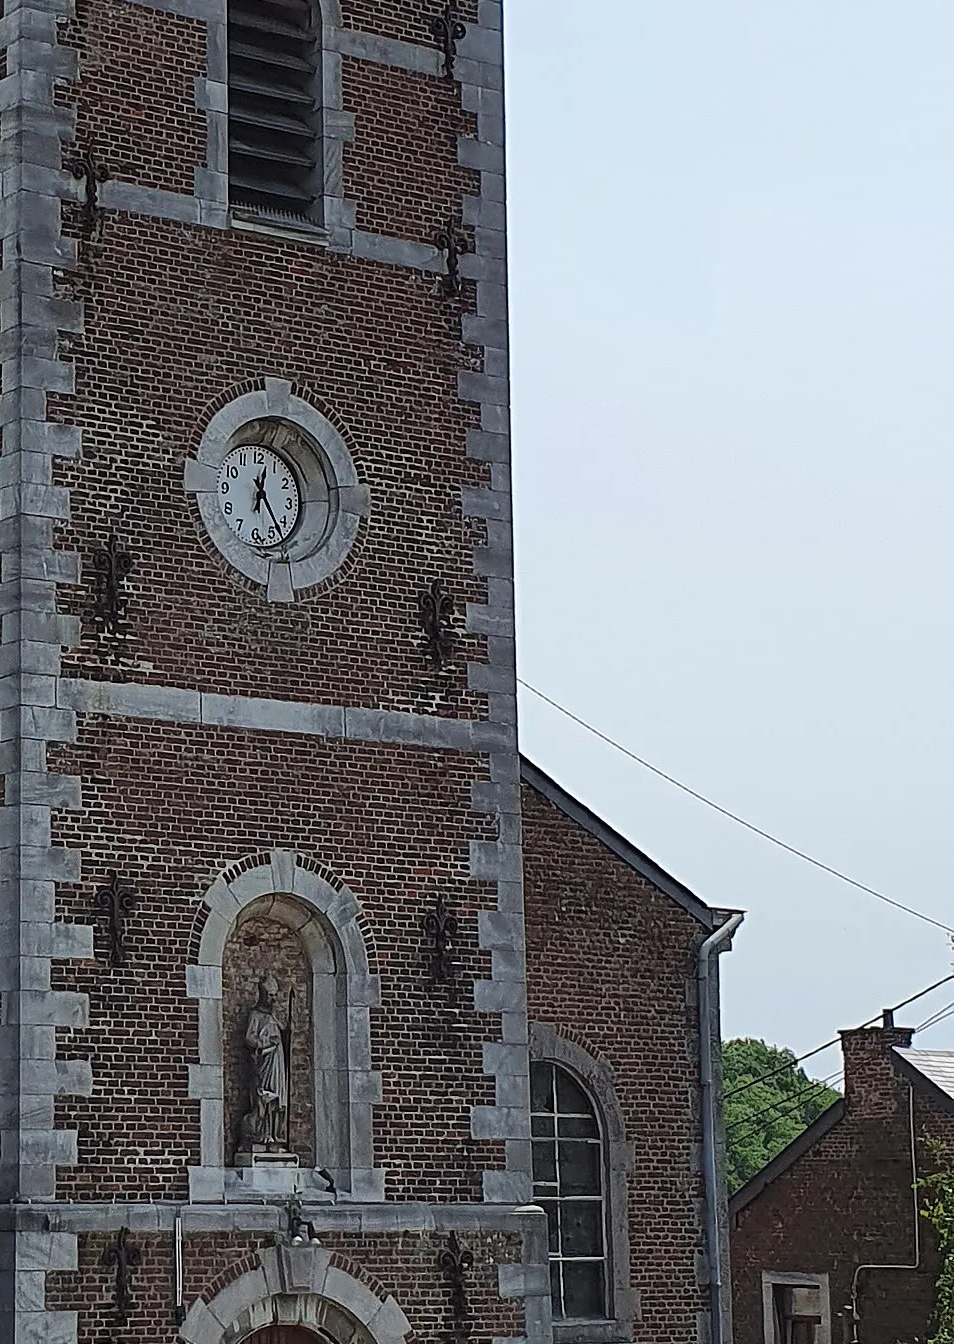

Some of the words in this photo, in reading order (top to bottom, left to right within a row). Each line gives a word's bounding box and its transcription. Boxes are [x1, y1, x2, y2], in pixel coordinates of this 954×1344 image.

[239, 452, 247, 466] 11
[253, 451, 264, 465] 12
[226, 465, 238, 479] 10
[273, 461, 277, 474] 1
[221, 482, 229, 494] 9
[281, 478, 289, 490] 2
[224, 502, 233, 515] 8
[285, 498, 293, 510] 3
[236, 519, 244, 531] 7
[280, 515, 287, 528] 4
[251, 528, 259, 540] 6
[267, 526, 276, 539] 5
